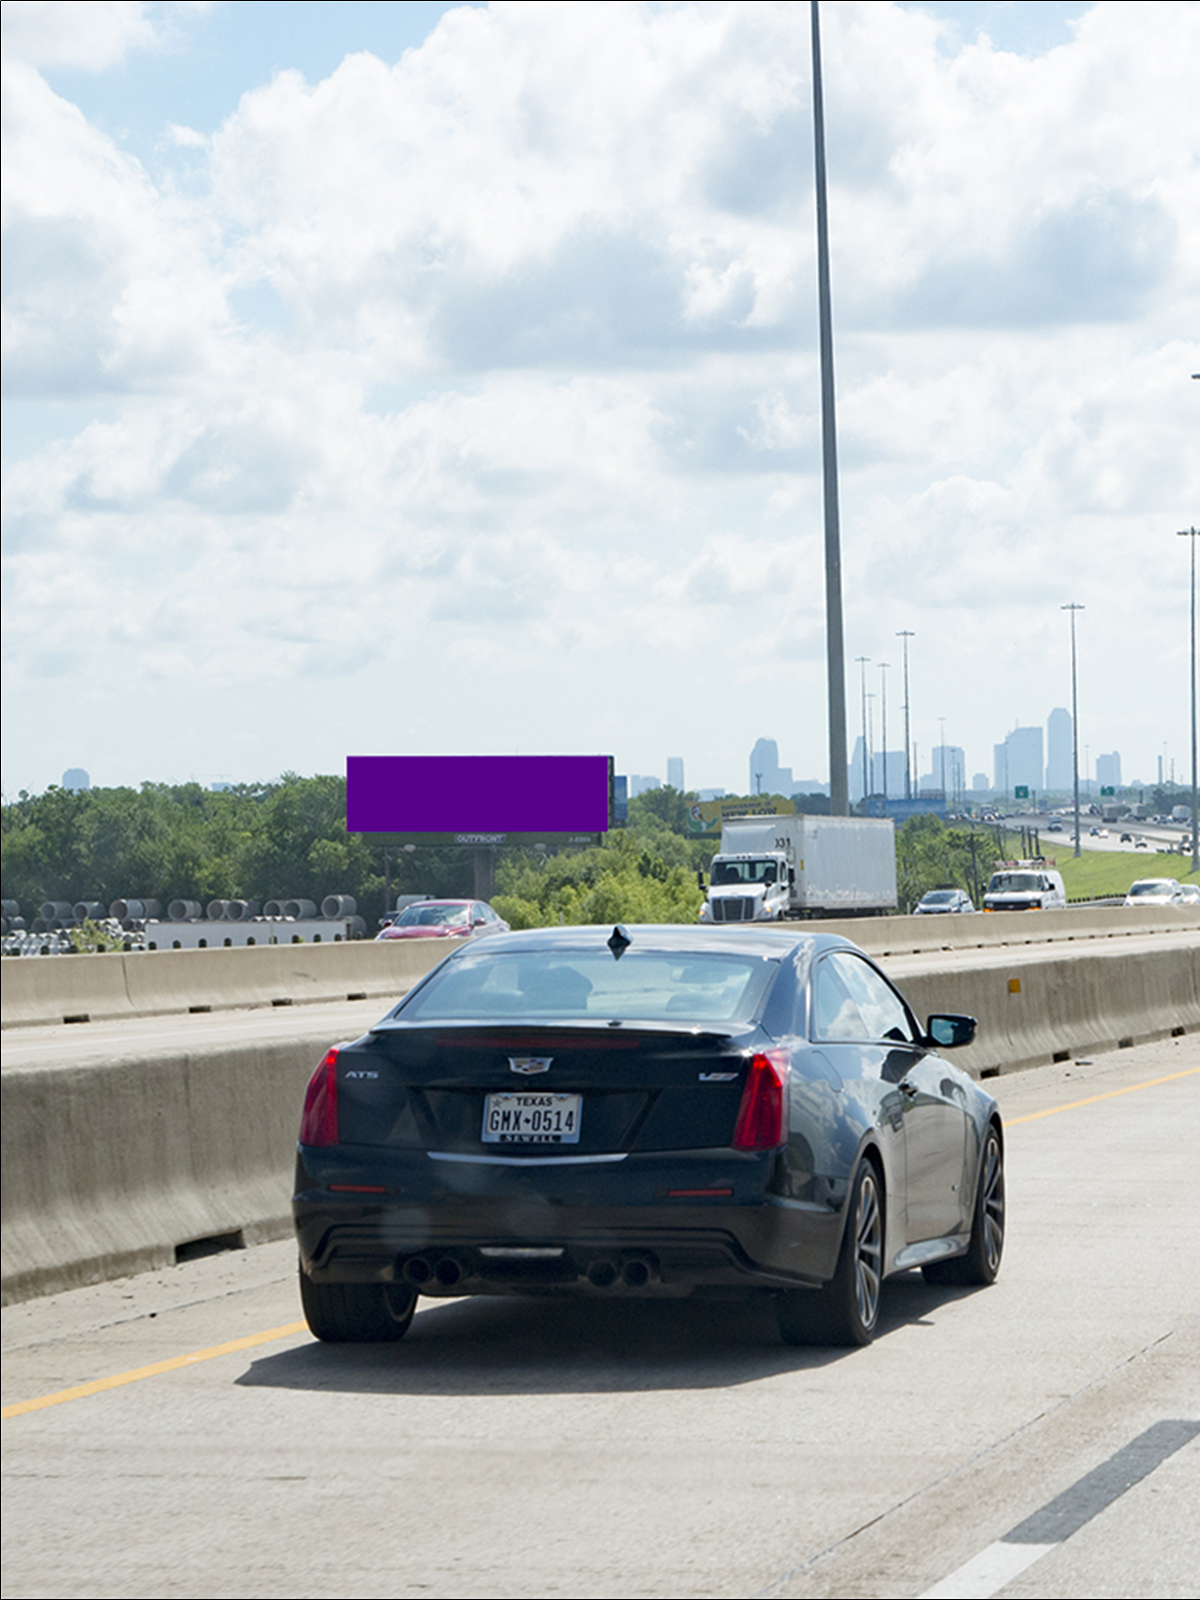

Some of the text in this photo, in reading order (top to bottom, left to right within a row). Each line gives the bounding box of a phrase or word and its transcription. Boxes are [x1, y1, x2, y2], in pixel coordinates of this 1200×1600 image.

[751, 806, 778, 816] LOW
[456, 833, 505, 844] OUTFRONT
[344, 1070, 379, 1079] ATS
[515, 1096, 554, 1108] TEXAS
[505, 1134, 555, 1143] SEWELL
